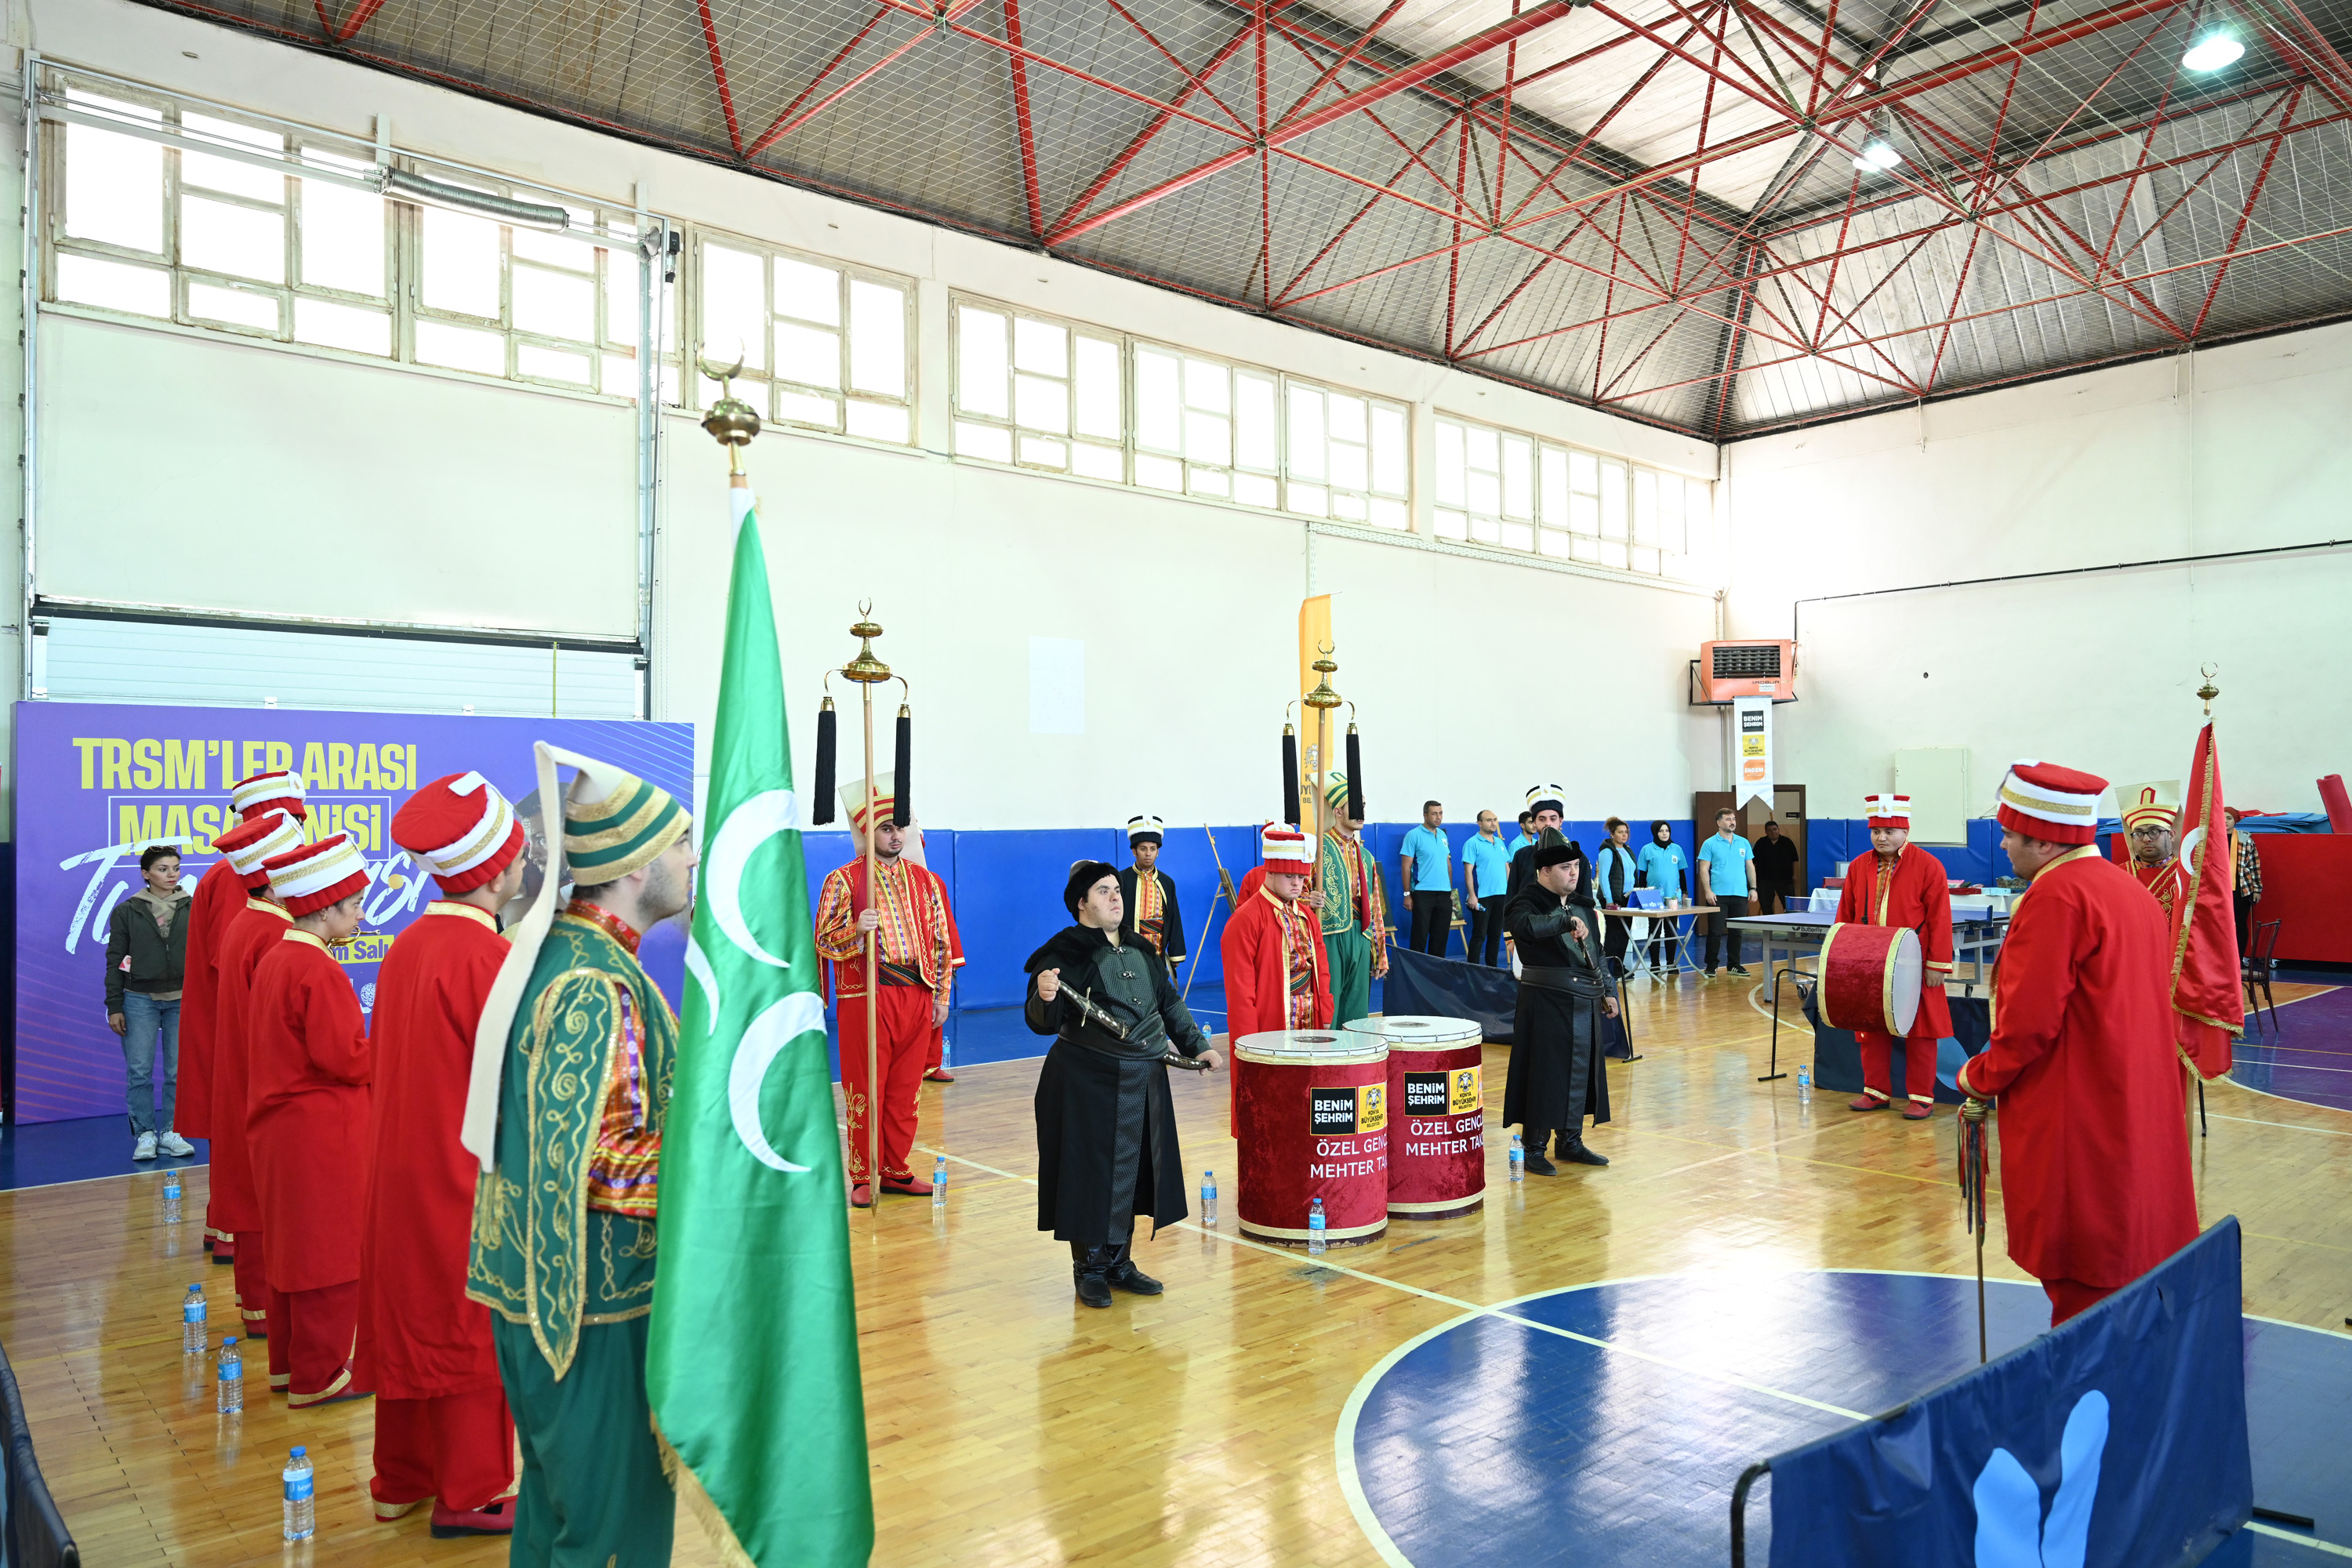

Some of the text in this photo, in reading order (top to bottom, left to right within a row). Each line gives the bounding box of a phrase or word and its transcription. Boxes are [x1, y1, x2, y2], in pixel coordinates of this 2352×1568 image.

[301, 742, 416, 790] ARASI
[1410, 1119, 1453, 1136] ÖZEL
[1316, 1138, 1360, 1156] ÖZEL
[1406, 1139, 1468, 1156] MEHTER
[1310, 1160, 1374, 1178] MEHTER
